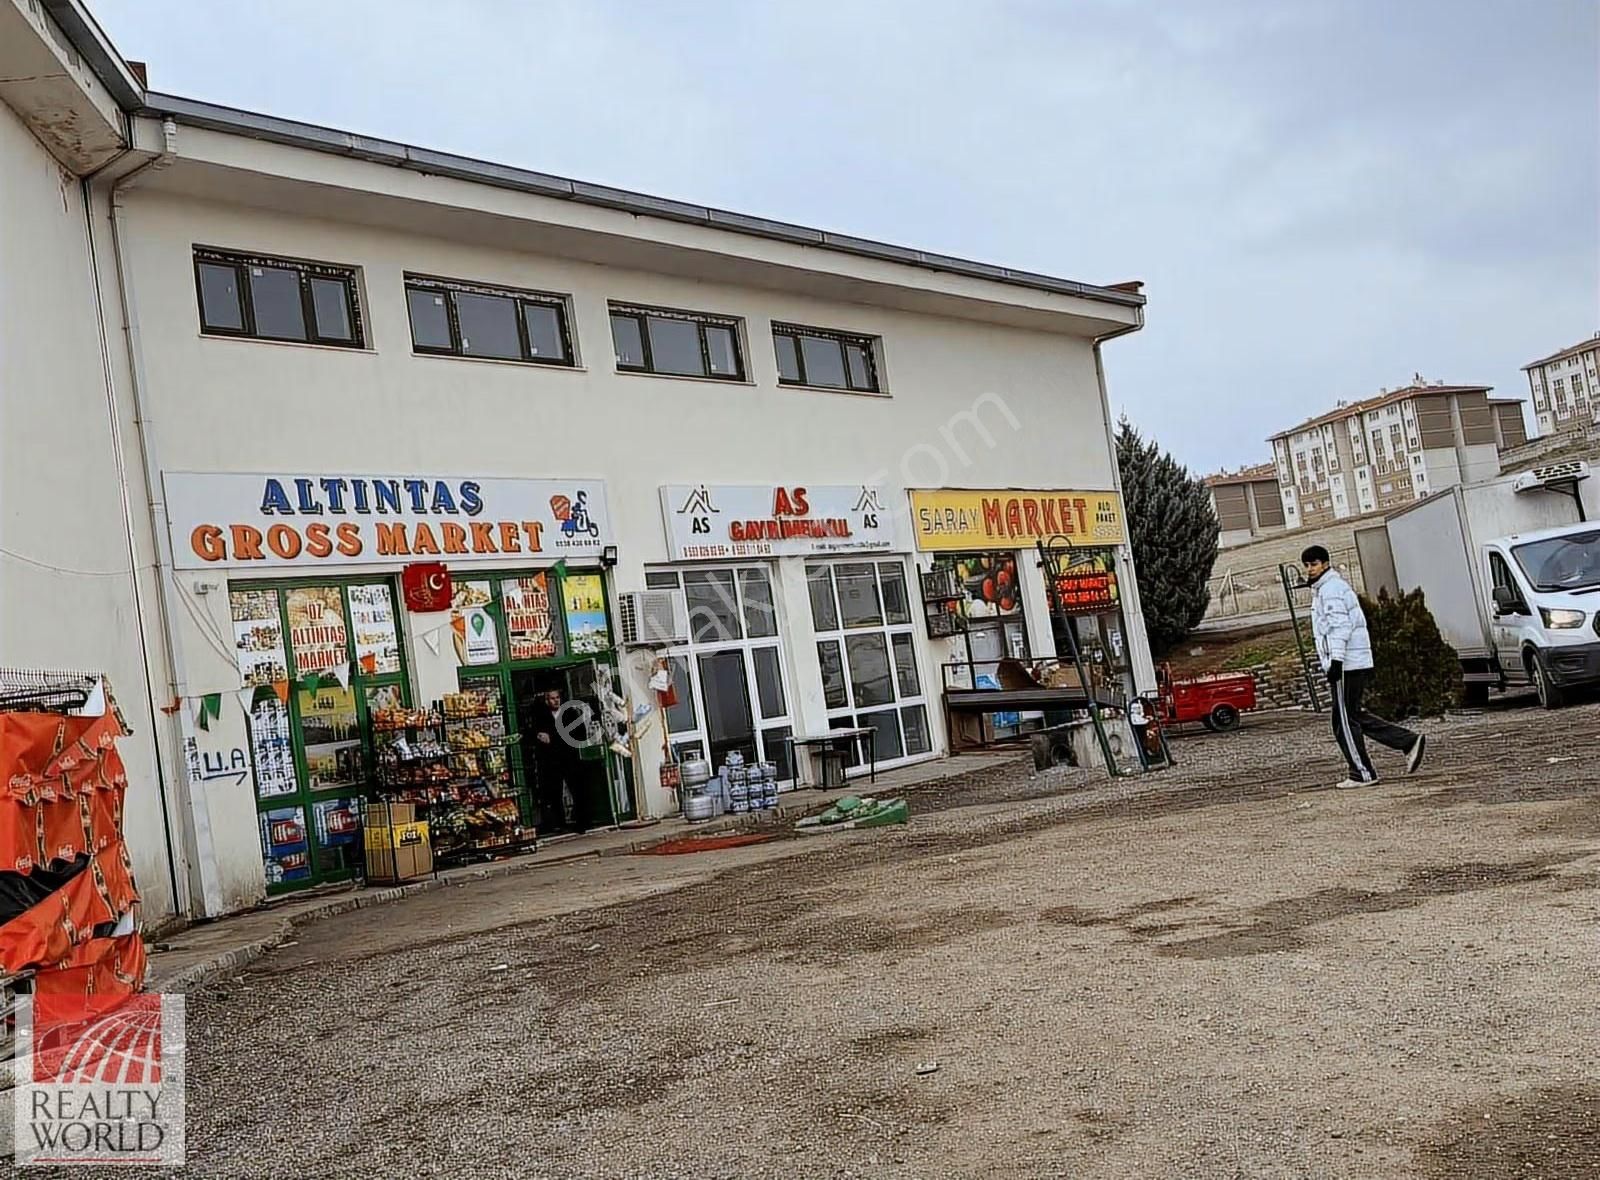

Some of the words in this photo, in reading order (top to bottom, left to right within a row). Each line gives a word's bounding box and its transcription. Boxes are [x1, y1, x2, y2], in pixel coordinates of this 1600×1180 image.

[773, 486, 809, 516] AS
[692, 517, 711, 534] AS
[864, 514, 878, 528] AS
[920, 508, 978, 533] SARAY
[981, 498, 1086, 538] MARKET
[191, 522, 362, 561] GROSS
[375, 520, 544, 555] MARKET
[298, 649, 345, 669] MARKET
